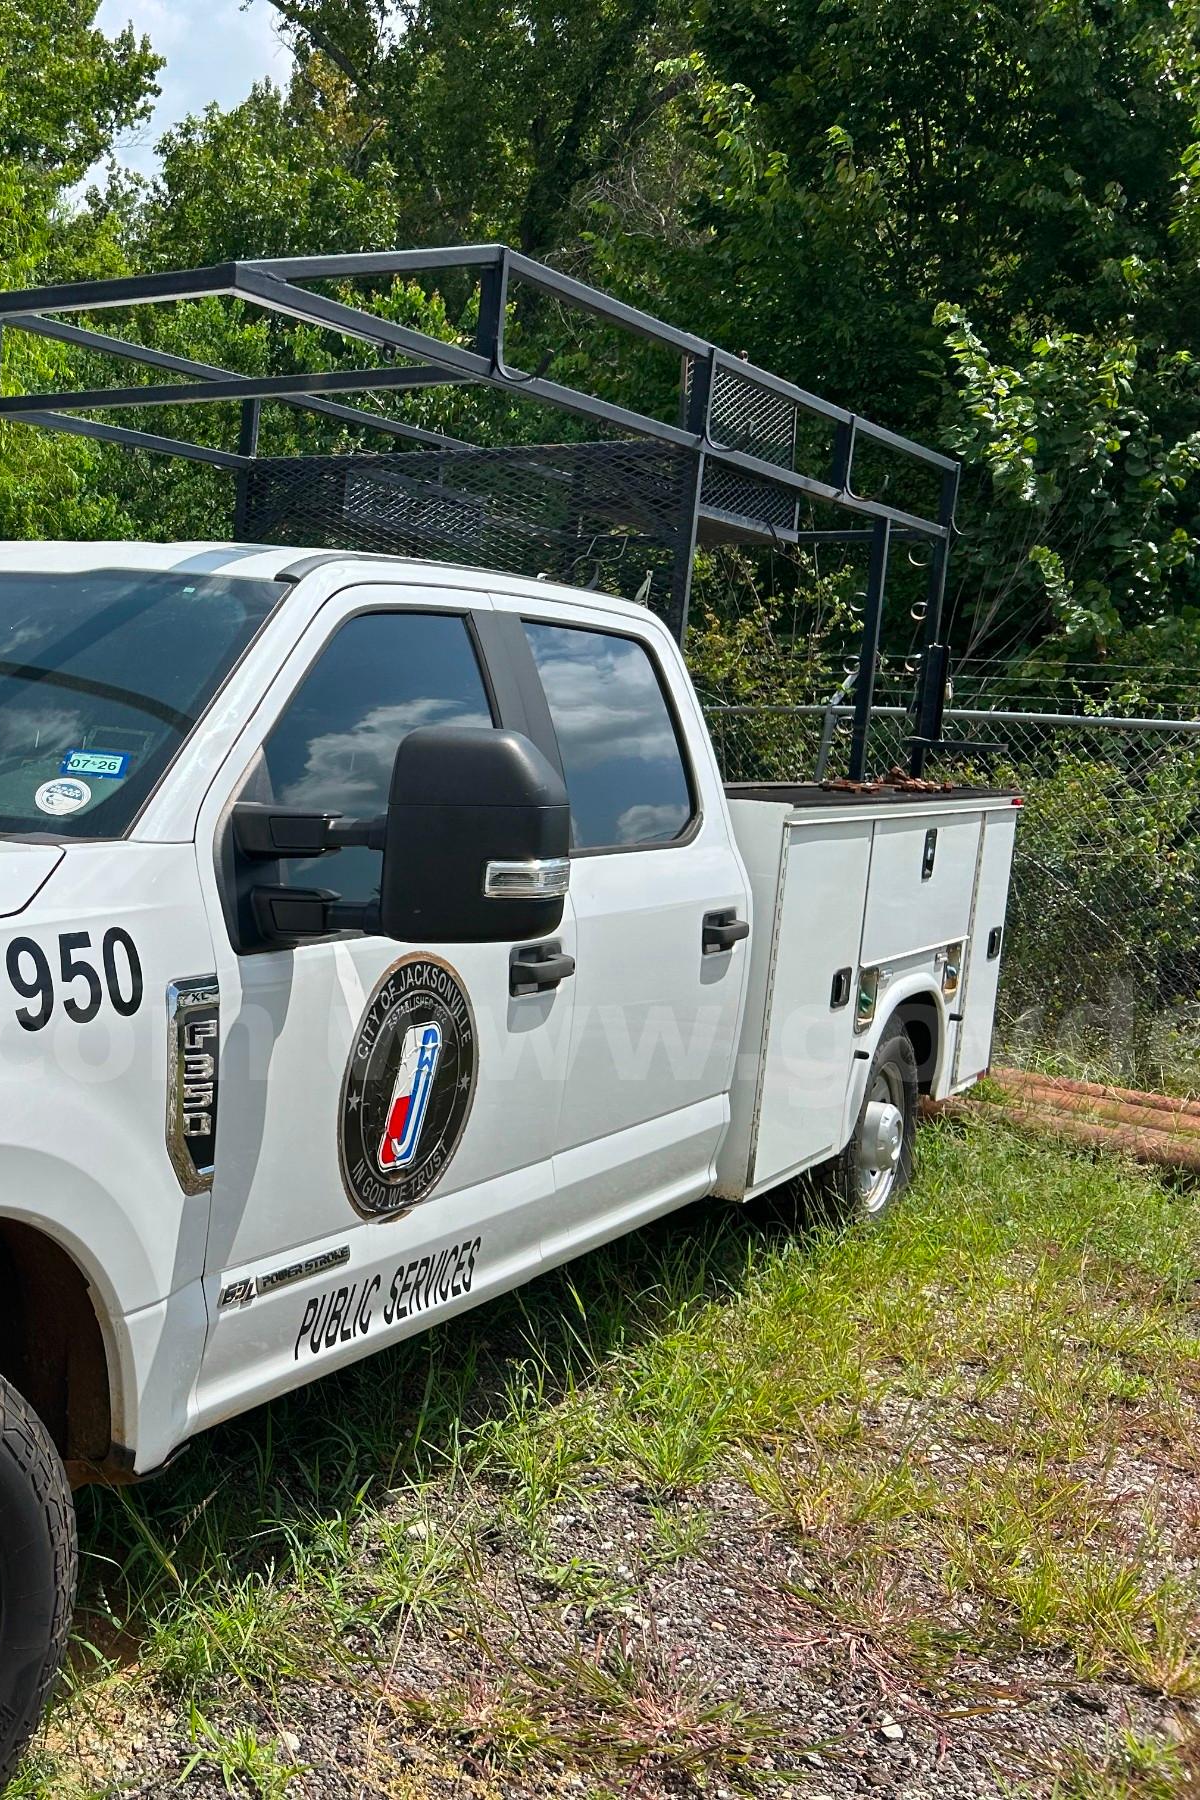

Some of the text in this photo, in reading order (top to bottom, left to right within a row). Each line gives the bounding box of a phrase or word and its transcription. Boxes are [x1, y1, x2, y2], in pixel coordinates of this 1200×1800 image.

[70, 758, 91, 769] 07
[97, 760, 118, 771] 26
[191, 992, 209, 1004] XL
[357, 964, 472, 1059] CITY OF JACKSONVILLE
[352, 1143, 448, 1208] IN GOD WE TRUST
[262, 1264, 303, 1288] POWER
[304, 1246, 350, 1272] STROKE
[294, 1236, 482, 1360] PUBLIC SERVICES
